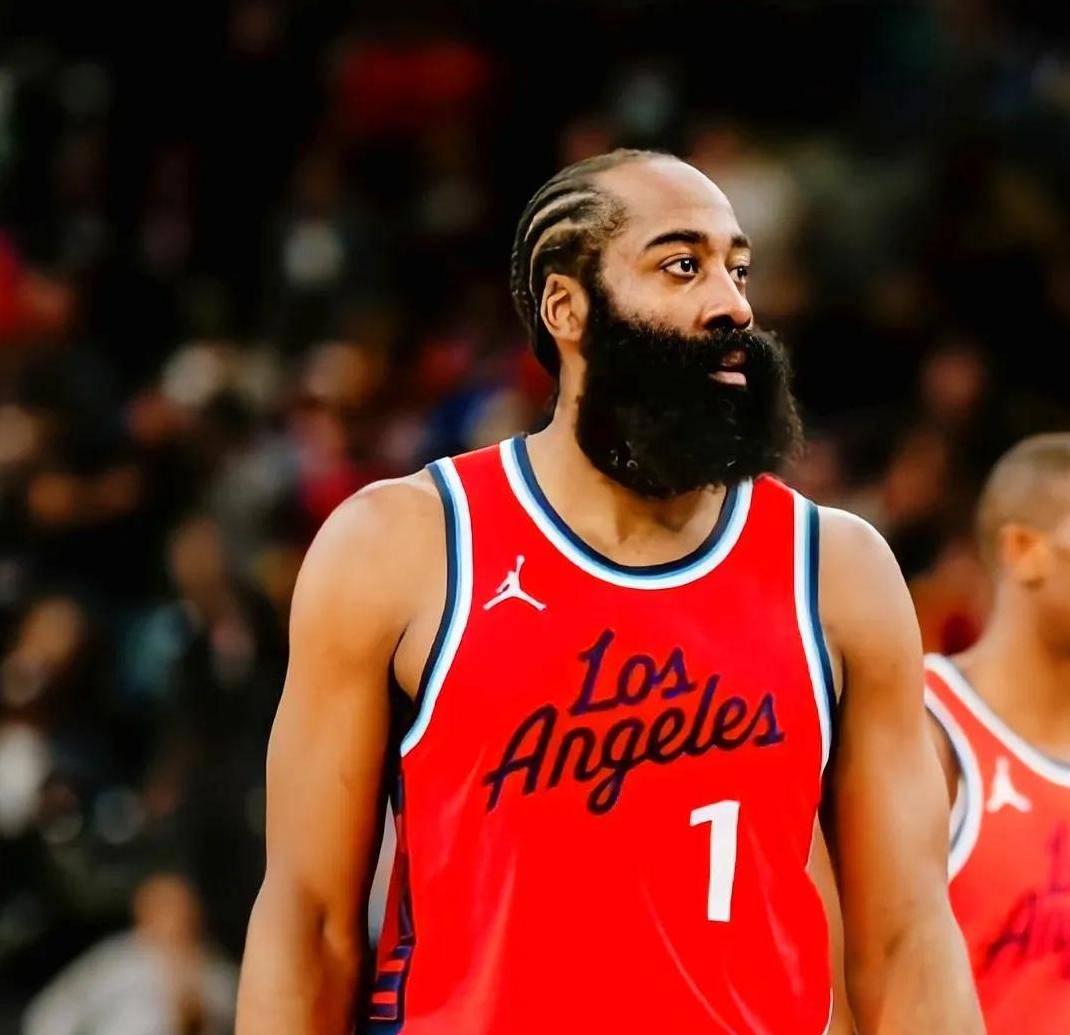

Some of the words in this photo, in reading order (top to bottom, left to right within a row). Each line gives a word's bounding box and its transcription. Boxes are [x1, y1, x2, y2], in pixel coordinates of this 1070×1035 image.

[569, 628, 698, 716] Los
[482, 673, 786, 816] Angeles
[689, 799, 741, 922] 1
